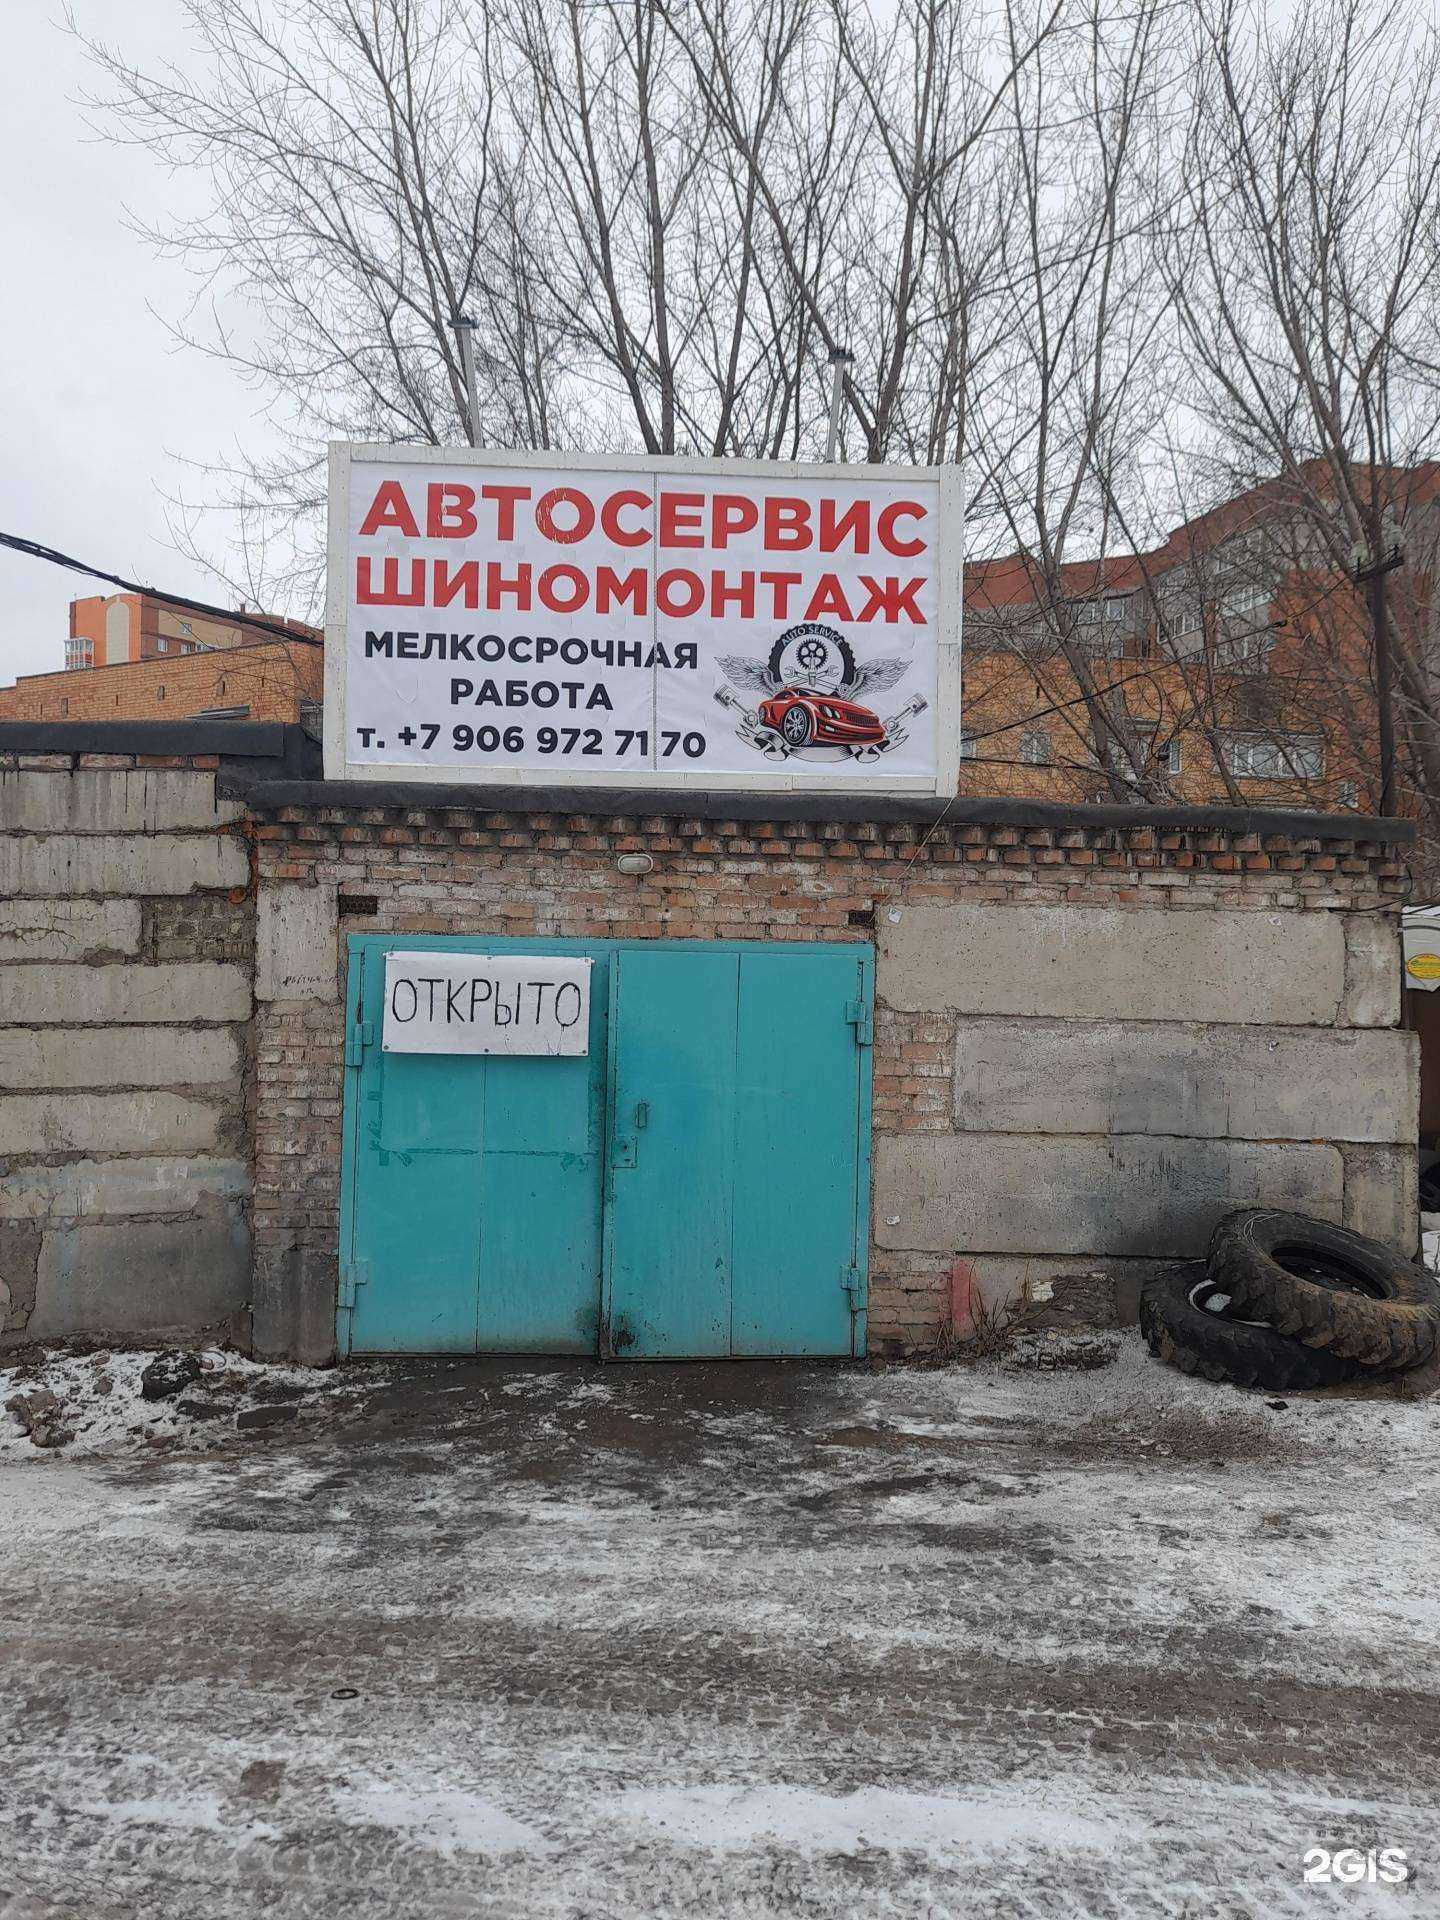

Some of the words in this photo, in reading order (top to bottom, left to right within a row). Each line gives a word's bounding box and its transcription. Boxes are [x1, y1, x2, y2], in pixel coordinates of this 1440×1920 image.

[358, 480, 929, 558] АВТОСЕРВИС
[356, 556, 928, 625] ШИНОМОНТАЖ
[364, 631, 698, 670] МЕЛКОСРОЧНАЯ
[781, 627, 806, 647] AUTO
[808, 625, 845, 647] SERVICE
[450, 678, 614, 711] РАБОТА
[398, 723, 441, 750] +7
[452, 724, 525, 753] 906
[536, 728, 604, 755] 972
[614, 729, 648, 757] 71
[660, 731, 706, 759] 70
[391, 978, 582, 1028] ОТКРЫТО
